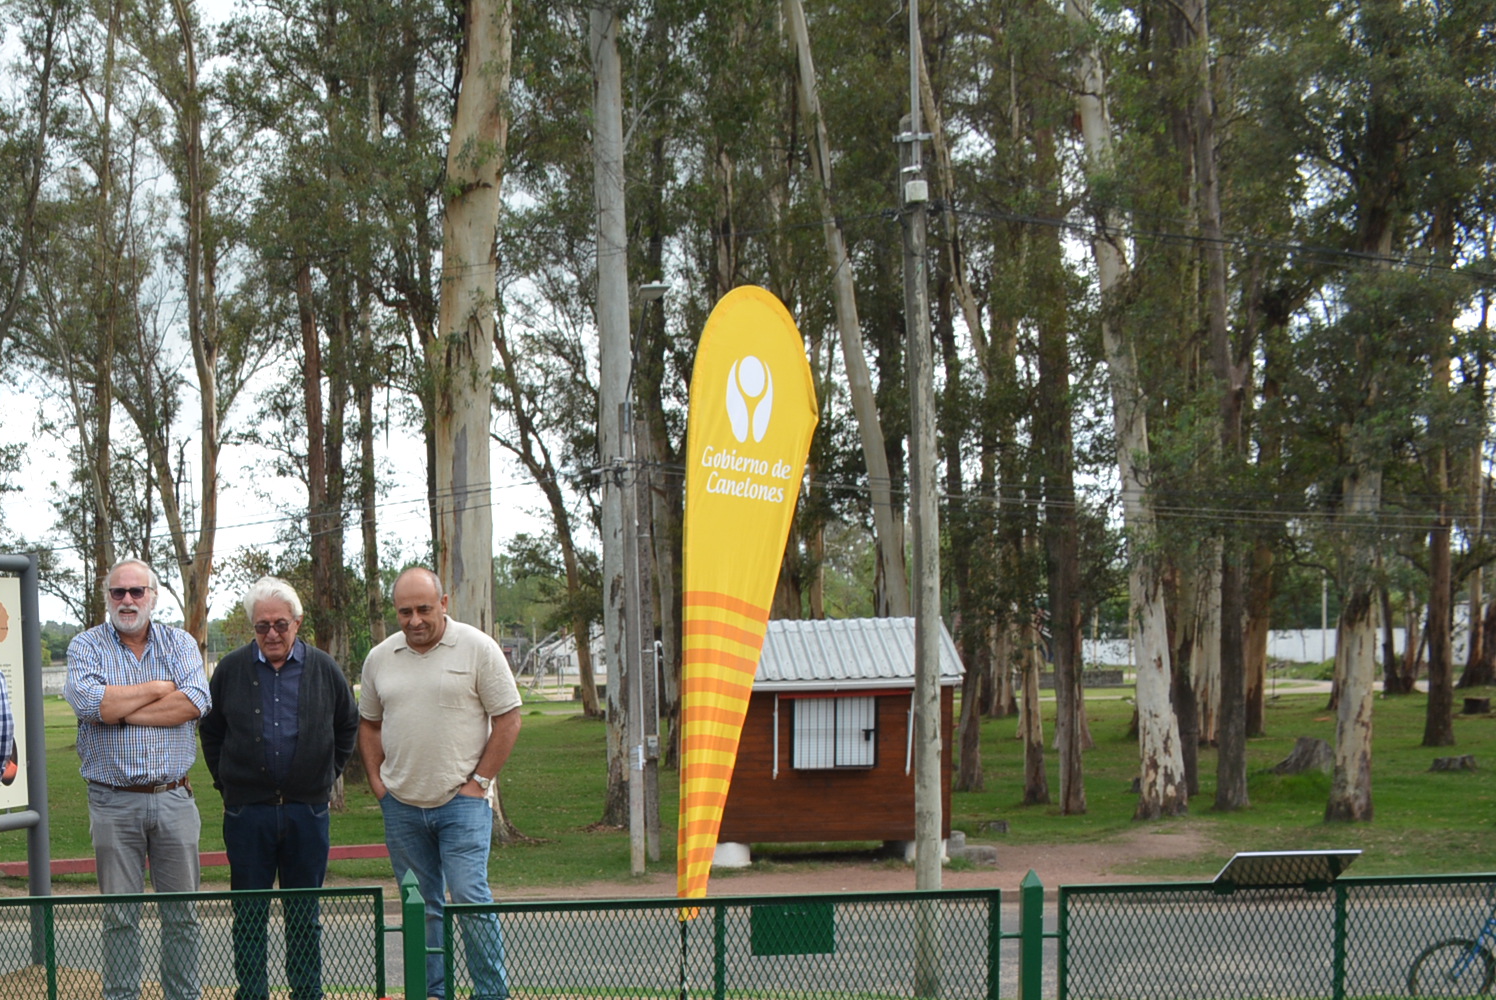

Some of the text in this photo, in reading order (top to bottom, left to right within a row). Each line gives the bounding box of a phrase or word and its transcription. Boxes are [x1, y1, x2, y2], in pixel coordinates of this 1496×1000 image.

[701, 445, 792, 480] Gobierno de
[706, 470, 784, 504] Canelones
